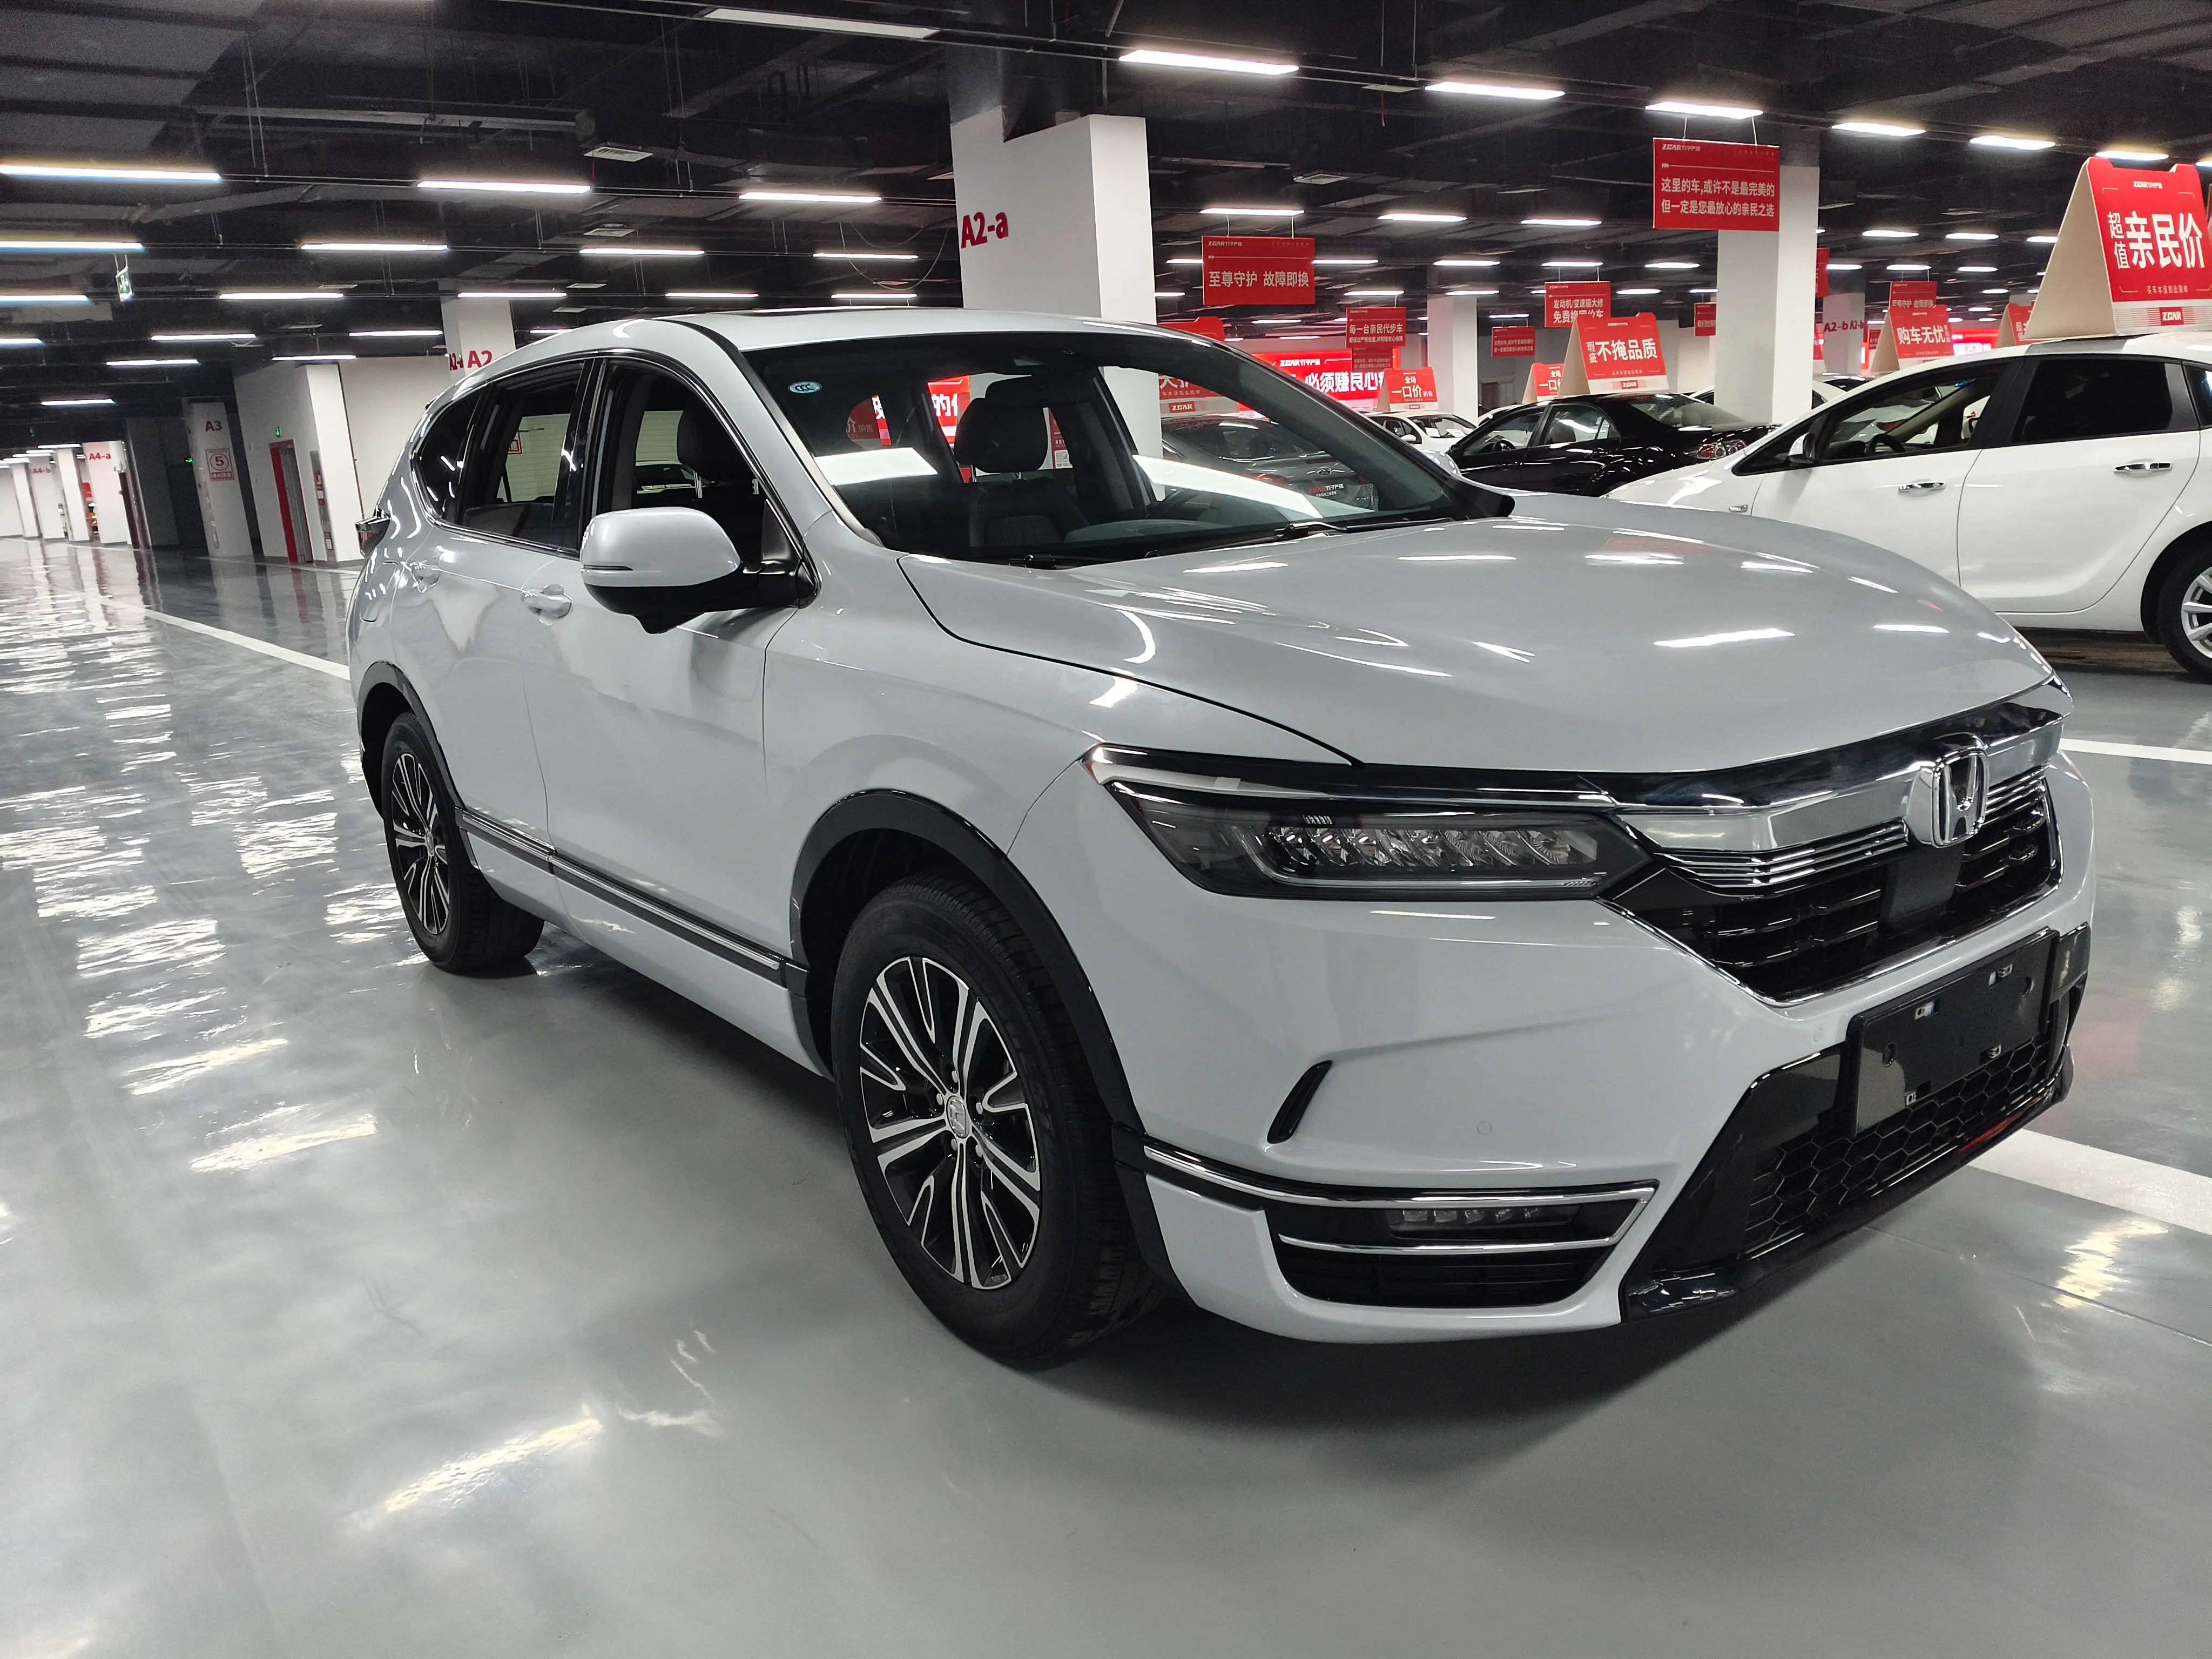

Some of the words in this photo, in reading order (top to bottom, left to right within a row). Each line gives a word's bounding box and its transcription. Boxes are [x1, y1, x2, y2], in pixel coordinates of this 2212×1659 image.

[1661, 178, 1775, 197] 这里的车,或许不是最完美的
[1661, 199, 1775, 217] 但一定是您最放心的亲民之选
[961, 212, 1009, 249] A2-a
[2125, 211, 2205, 268] 亲民价
[2107, 211, 2130, 269] 超值
[1209, 271, 1258, 287] 至尊守护
[1263, 271, 1309, 287] 故障即换
[2162, 311, 2182, 321] ZCAR
[1349, 323, 1403, 335] 每一台亲民代步车
[1823, 321, 1849, 333] A2-b
[1896, 325, 1945, 345] 购车无忧
[1595, 338, 1658, 361] 不掩品质
[468, 350, 493, 368] A2
[1392, 384, 1422, 398] 一口价
[206, 421, 222, 431] A3
[215, 456, 224, 466] 5
